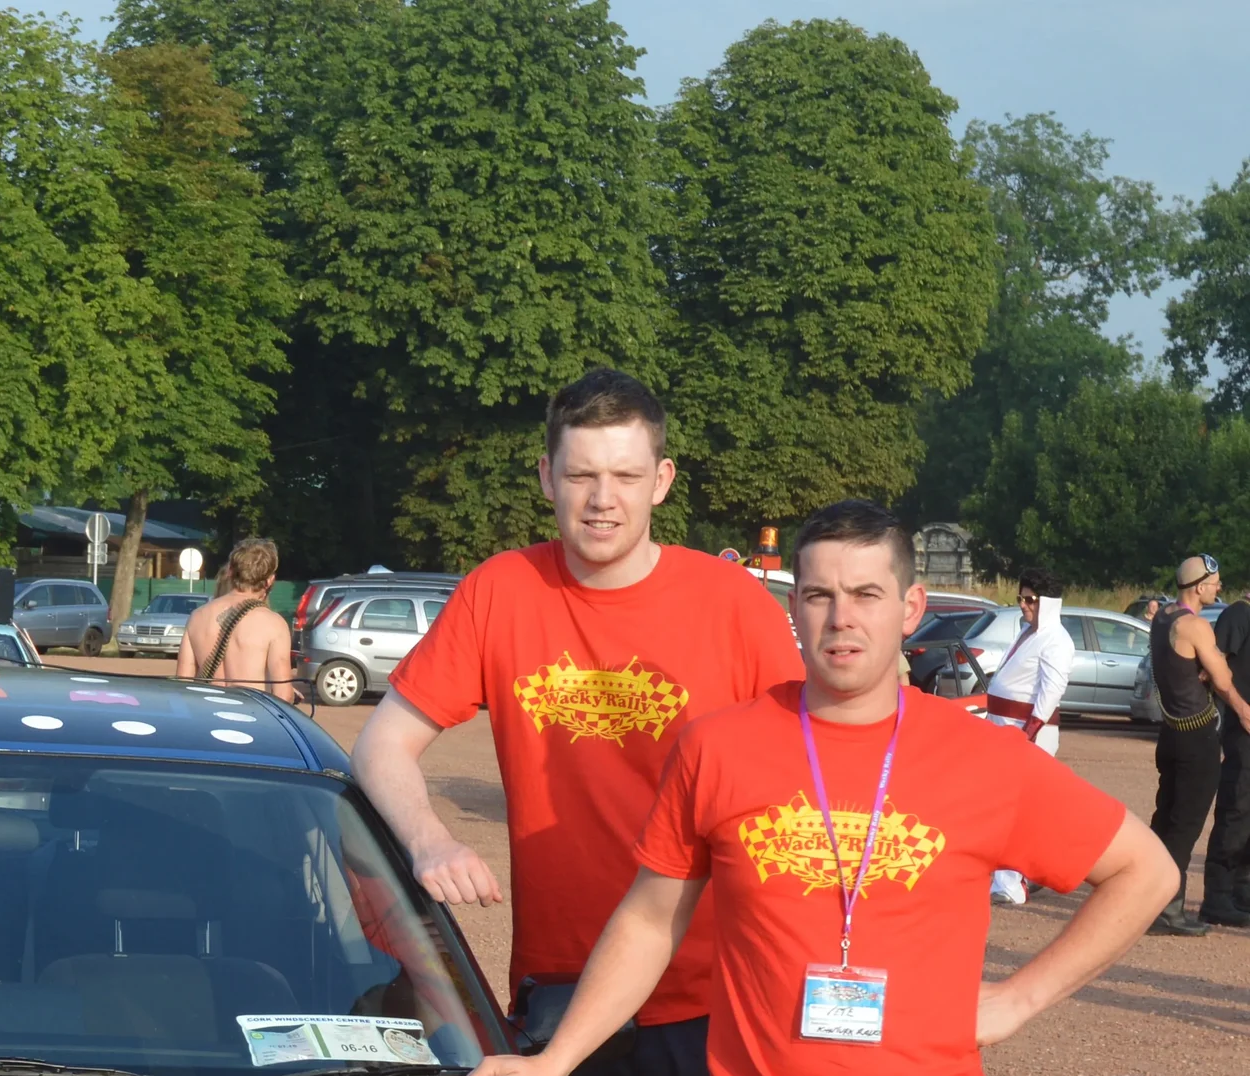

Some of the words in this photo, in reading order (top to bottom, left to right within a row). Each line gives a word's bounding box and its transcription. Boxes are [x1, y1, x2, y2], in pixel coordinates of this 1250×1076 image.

[543, 689, 603, 709] Wacky
[606, 692, 653, 715] Rally
[848, 836, 905, 862] Rlly
[341, 1044, 378, 1053] 06-16
